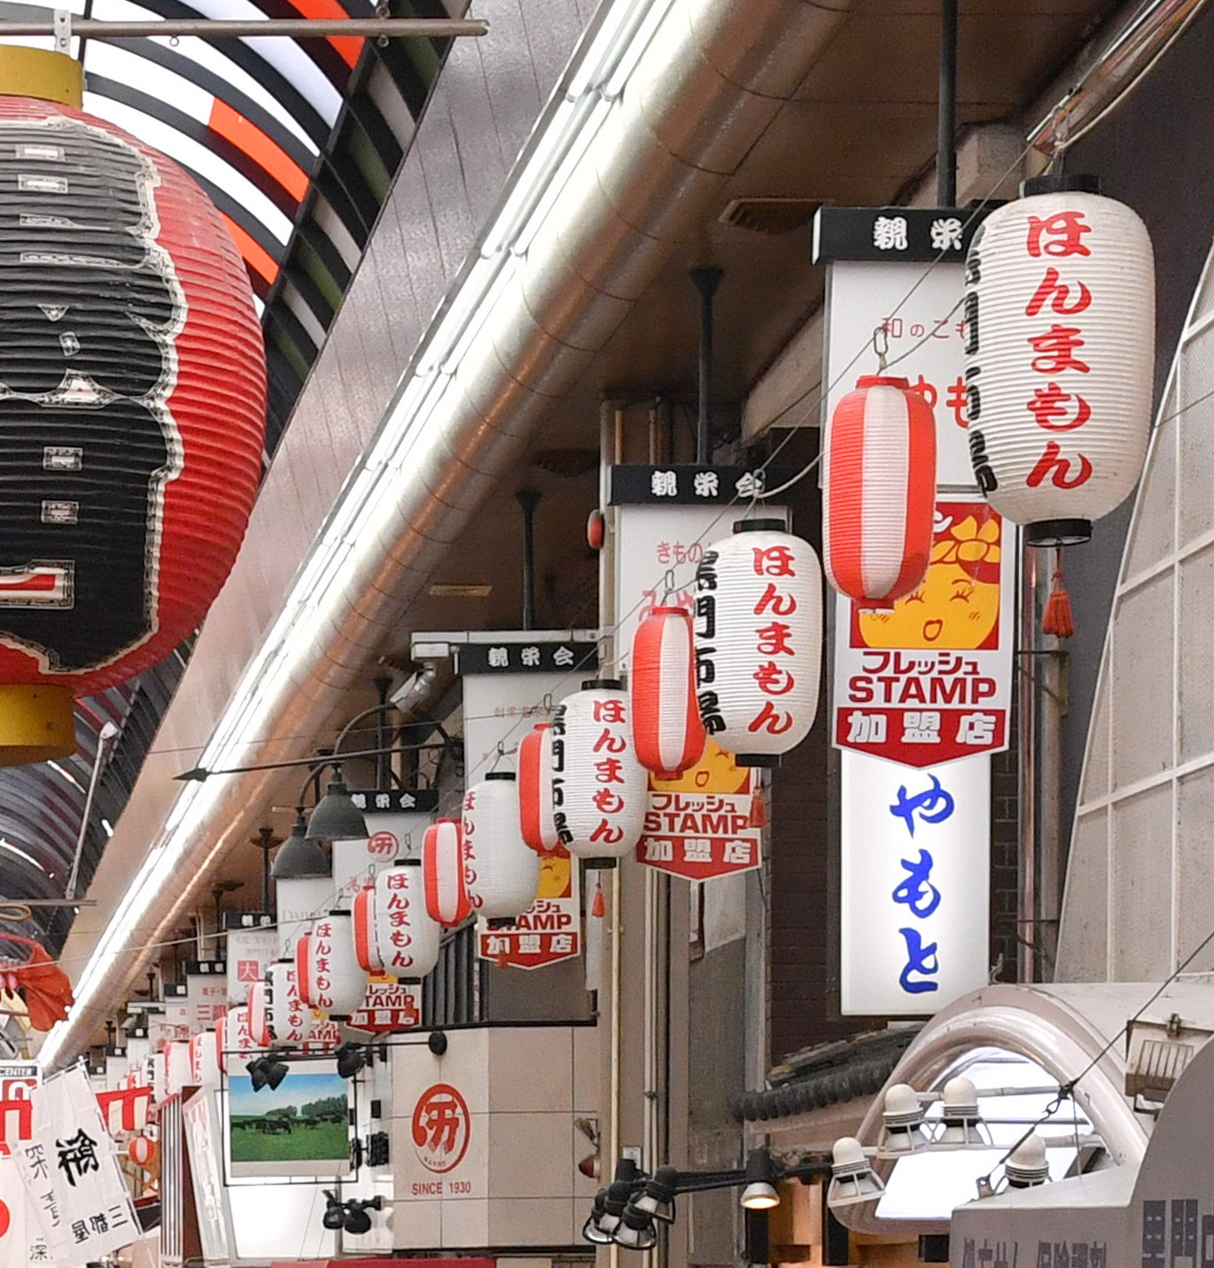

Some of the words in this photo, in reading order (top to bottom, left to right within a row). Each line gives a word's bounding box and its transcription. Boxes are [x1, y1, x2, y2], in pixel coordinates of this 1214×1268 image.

[1025, 211, 1092, 490] ほんまもん
[651, 470, 765, 498] 親栄会
[748, 544, 798, 737] ほんまもん
[488, 646, 574, 667] 親栄会
[861, 651, 980, 675] フレッシュ
[849, 676, 997, 704] STAMP
[847, 710, 996, 746] 加盟店
[590, 699, 627, 844] ほんまもん
[651, 792, 737, 814] フレッシュ
[644, 813, 749, 834] STAMP
[643, 839, 752, 863] 加盟店
[889, 773, 955, 995] やもと
[386, 873, 414, 967] ほんまもん
[486, 914, 572, 931] AMP
[486, 935, 573, 954] 加盟店
[316, 921, 334, 1009] ほんまもん
[365, 995, 415, 1008] TAMP
[369, 985, 406, 995] レッシュ
[412, 1182, 443, 1195] SINCE
[449, 1181, 472, 1194] 1930
